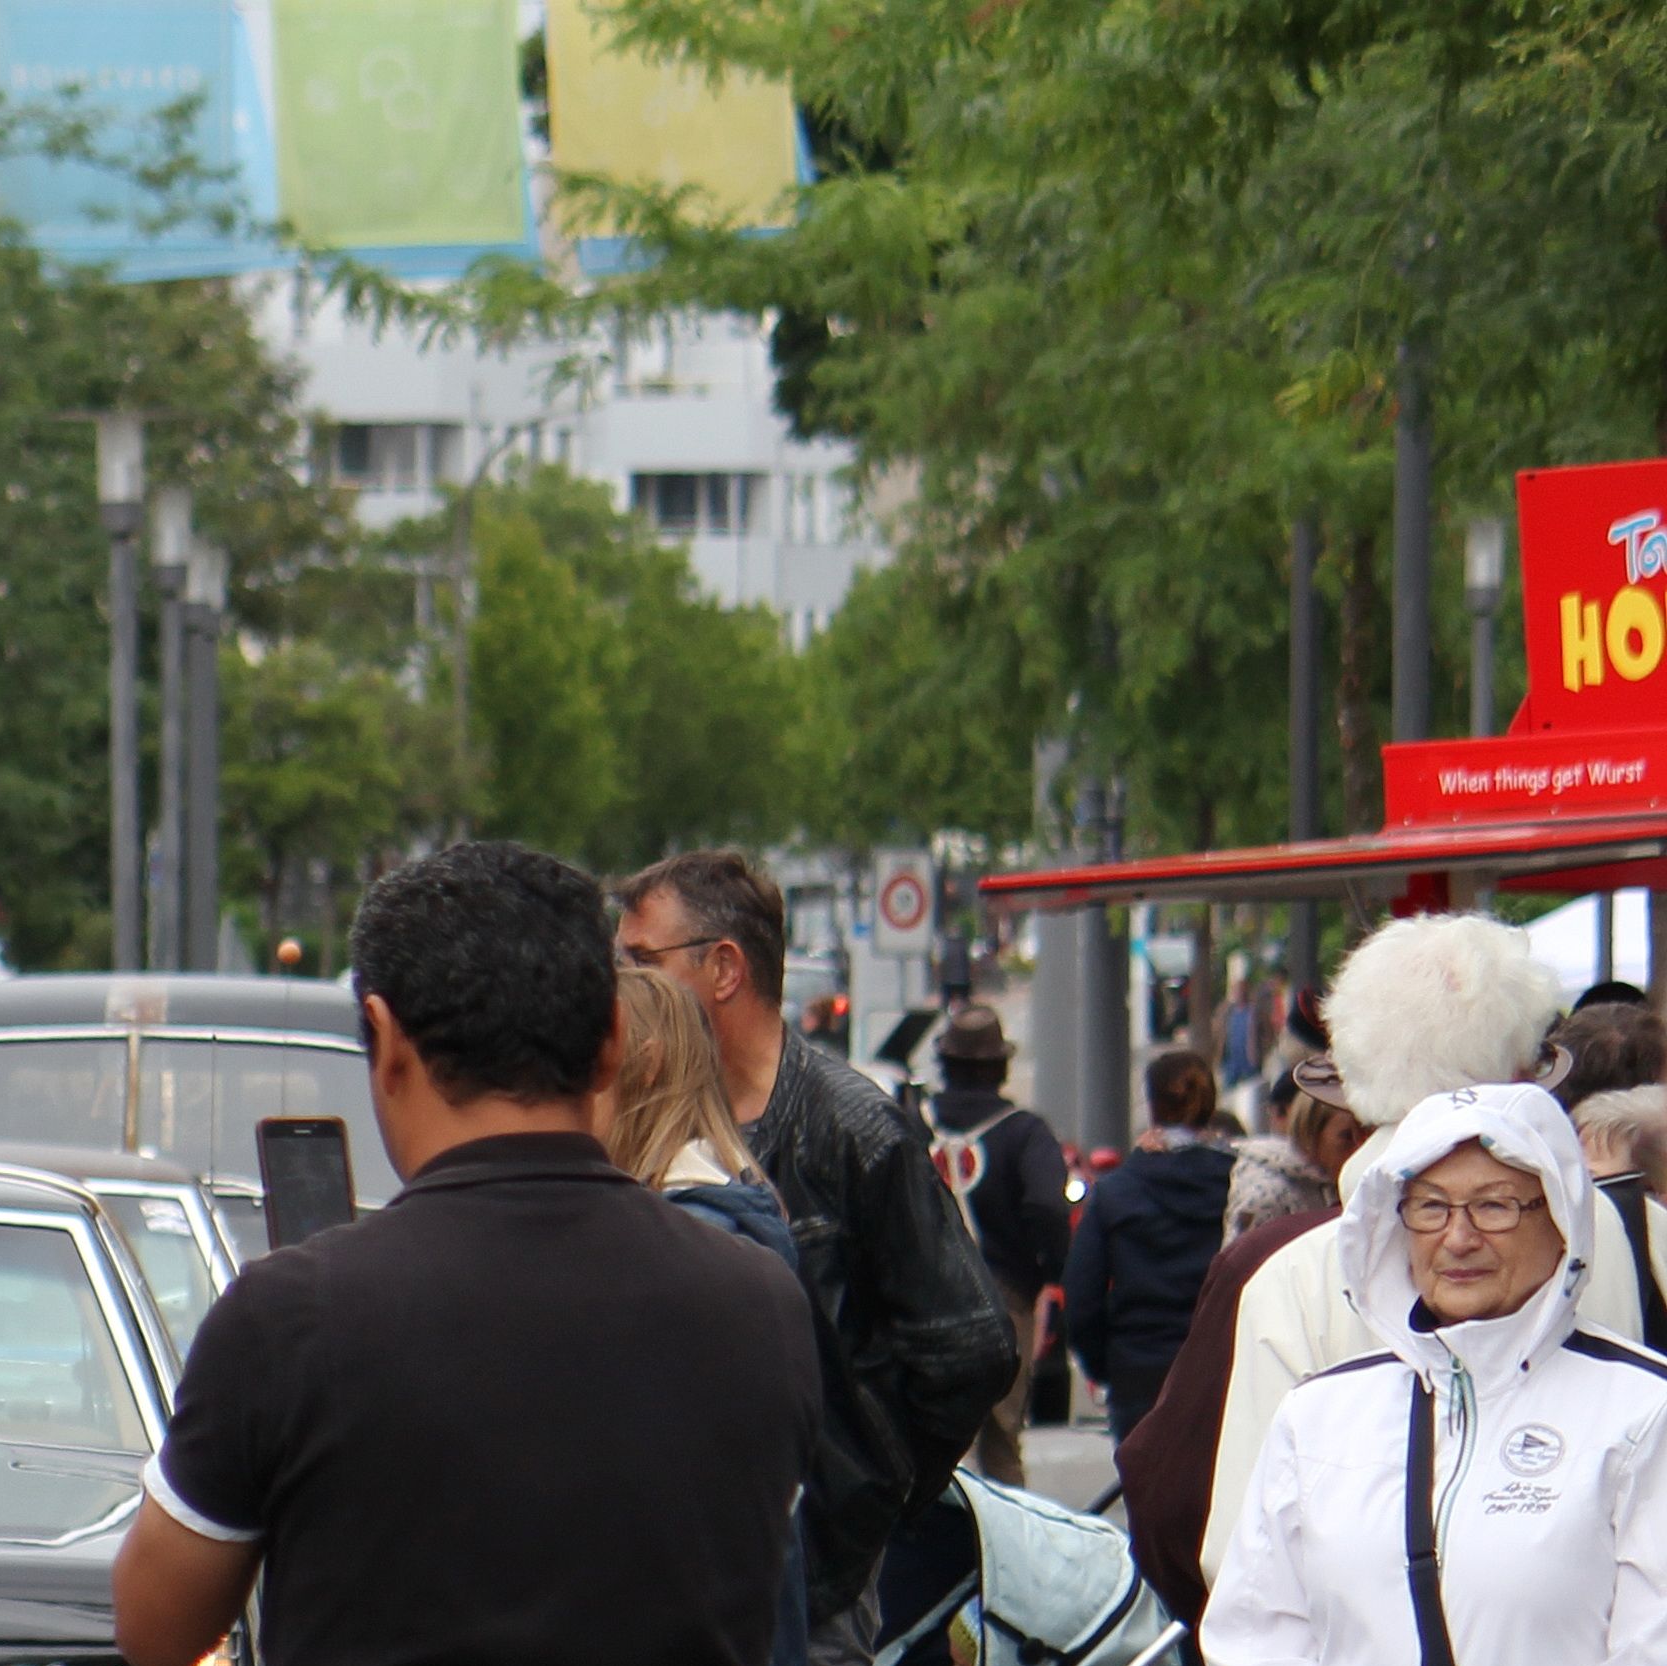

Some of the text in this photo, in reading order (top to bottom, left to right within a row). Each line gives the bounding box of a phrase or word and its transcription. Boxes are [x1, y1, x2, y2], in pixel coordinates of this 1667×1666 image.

[1560, 585, 1667, 693] HO
[1439, 759, 1647, 796] When things get Wurst
